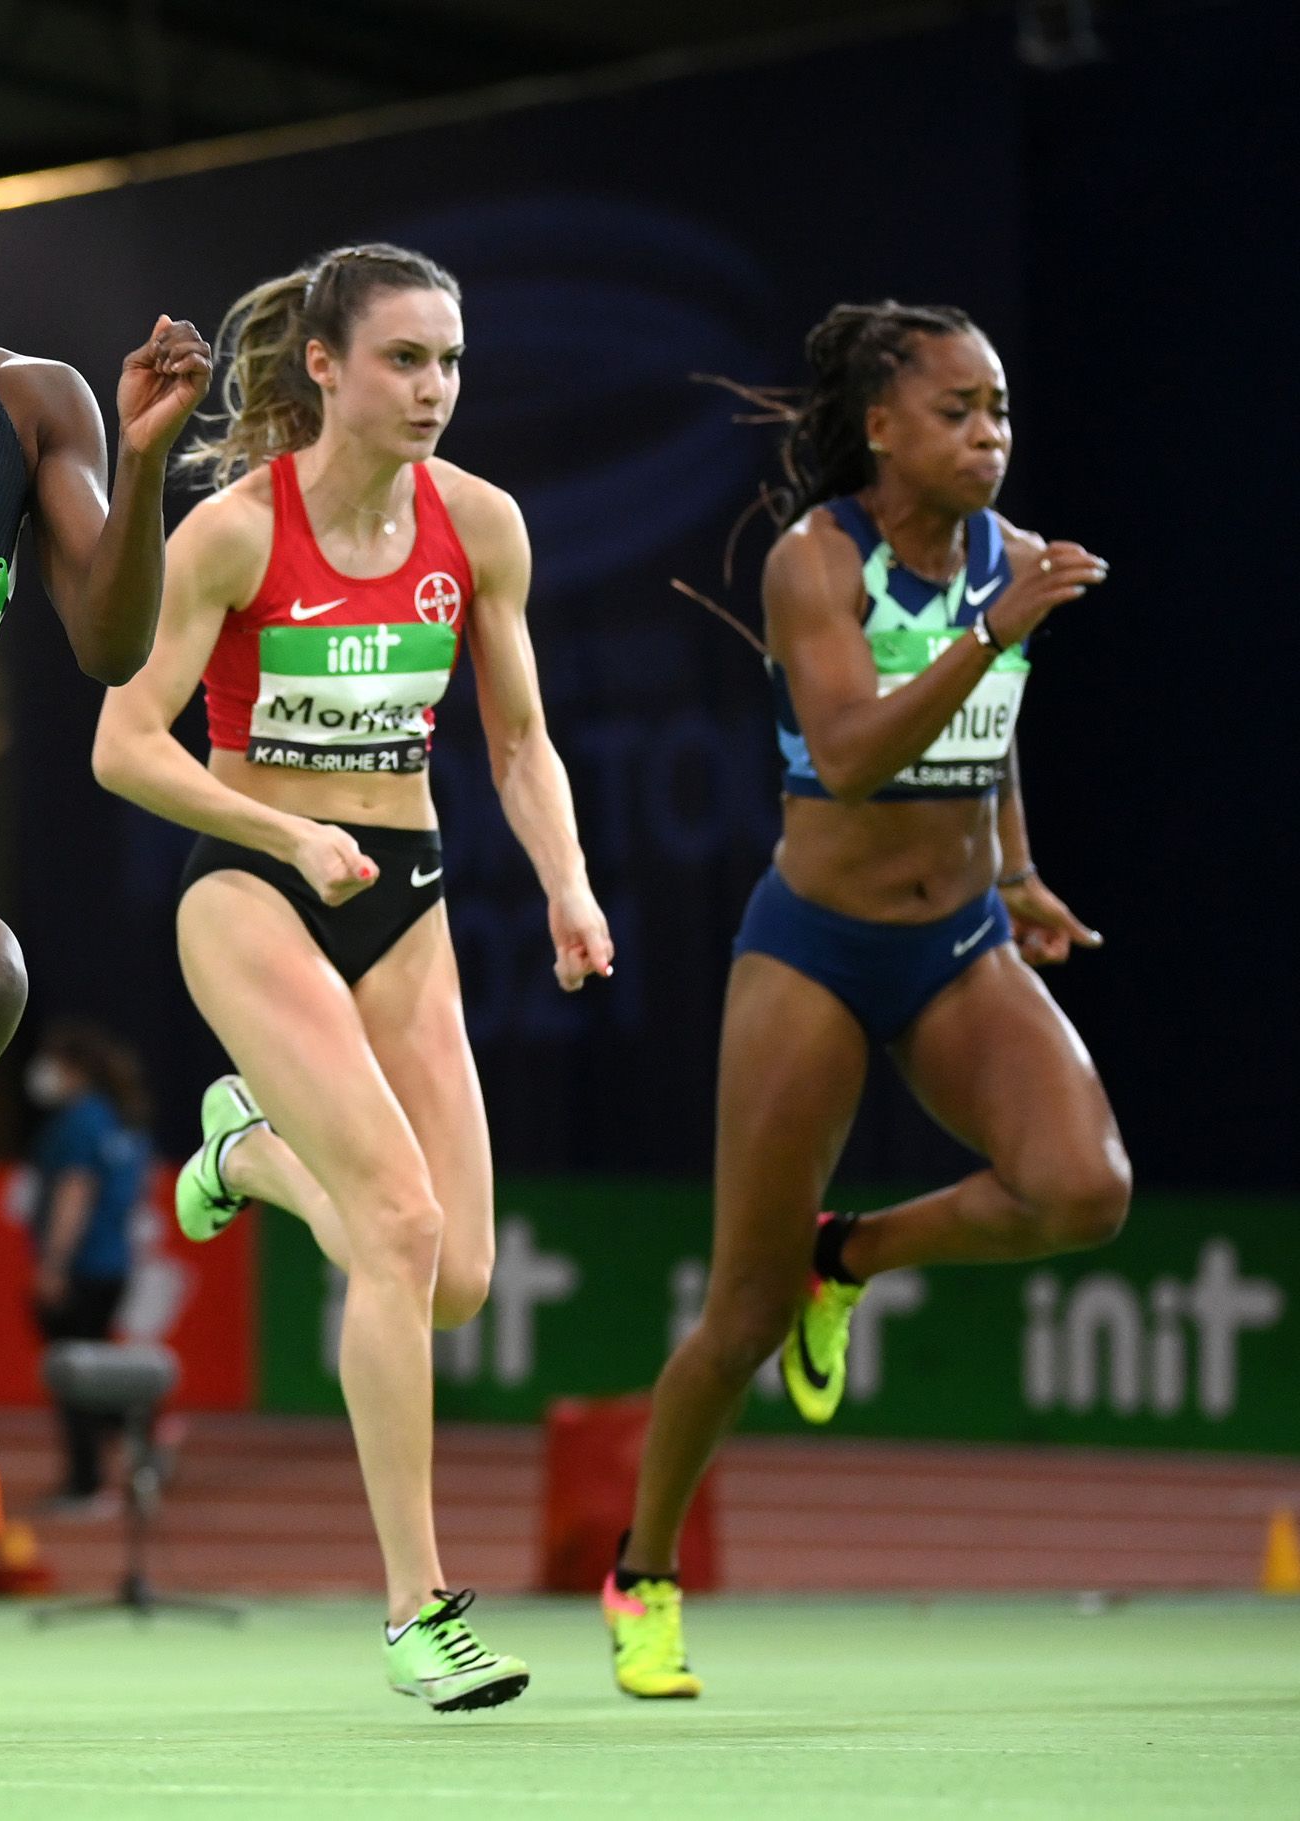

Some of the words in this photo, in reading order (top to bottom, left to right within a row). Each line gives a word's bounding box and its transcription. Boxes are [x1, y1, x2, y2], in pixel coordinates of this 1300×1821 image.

[327, 623, 401, 673] init
[254, 745, 376, 772] KARLSRUHE
[378, 750, 399, 770] 21
[1024, 1239, 1283, 1418] init
